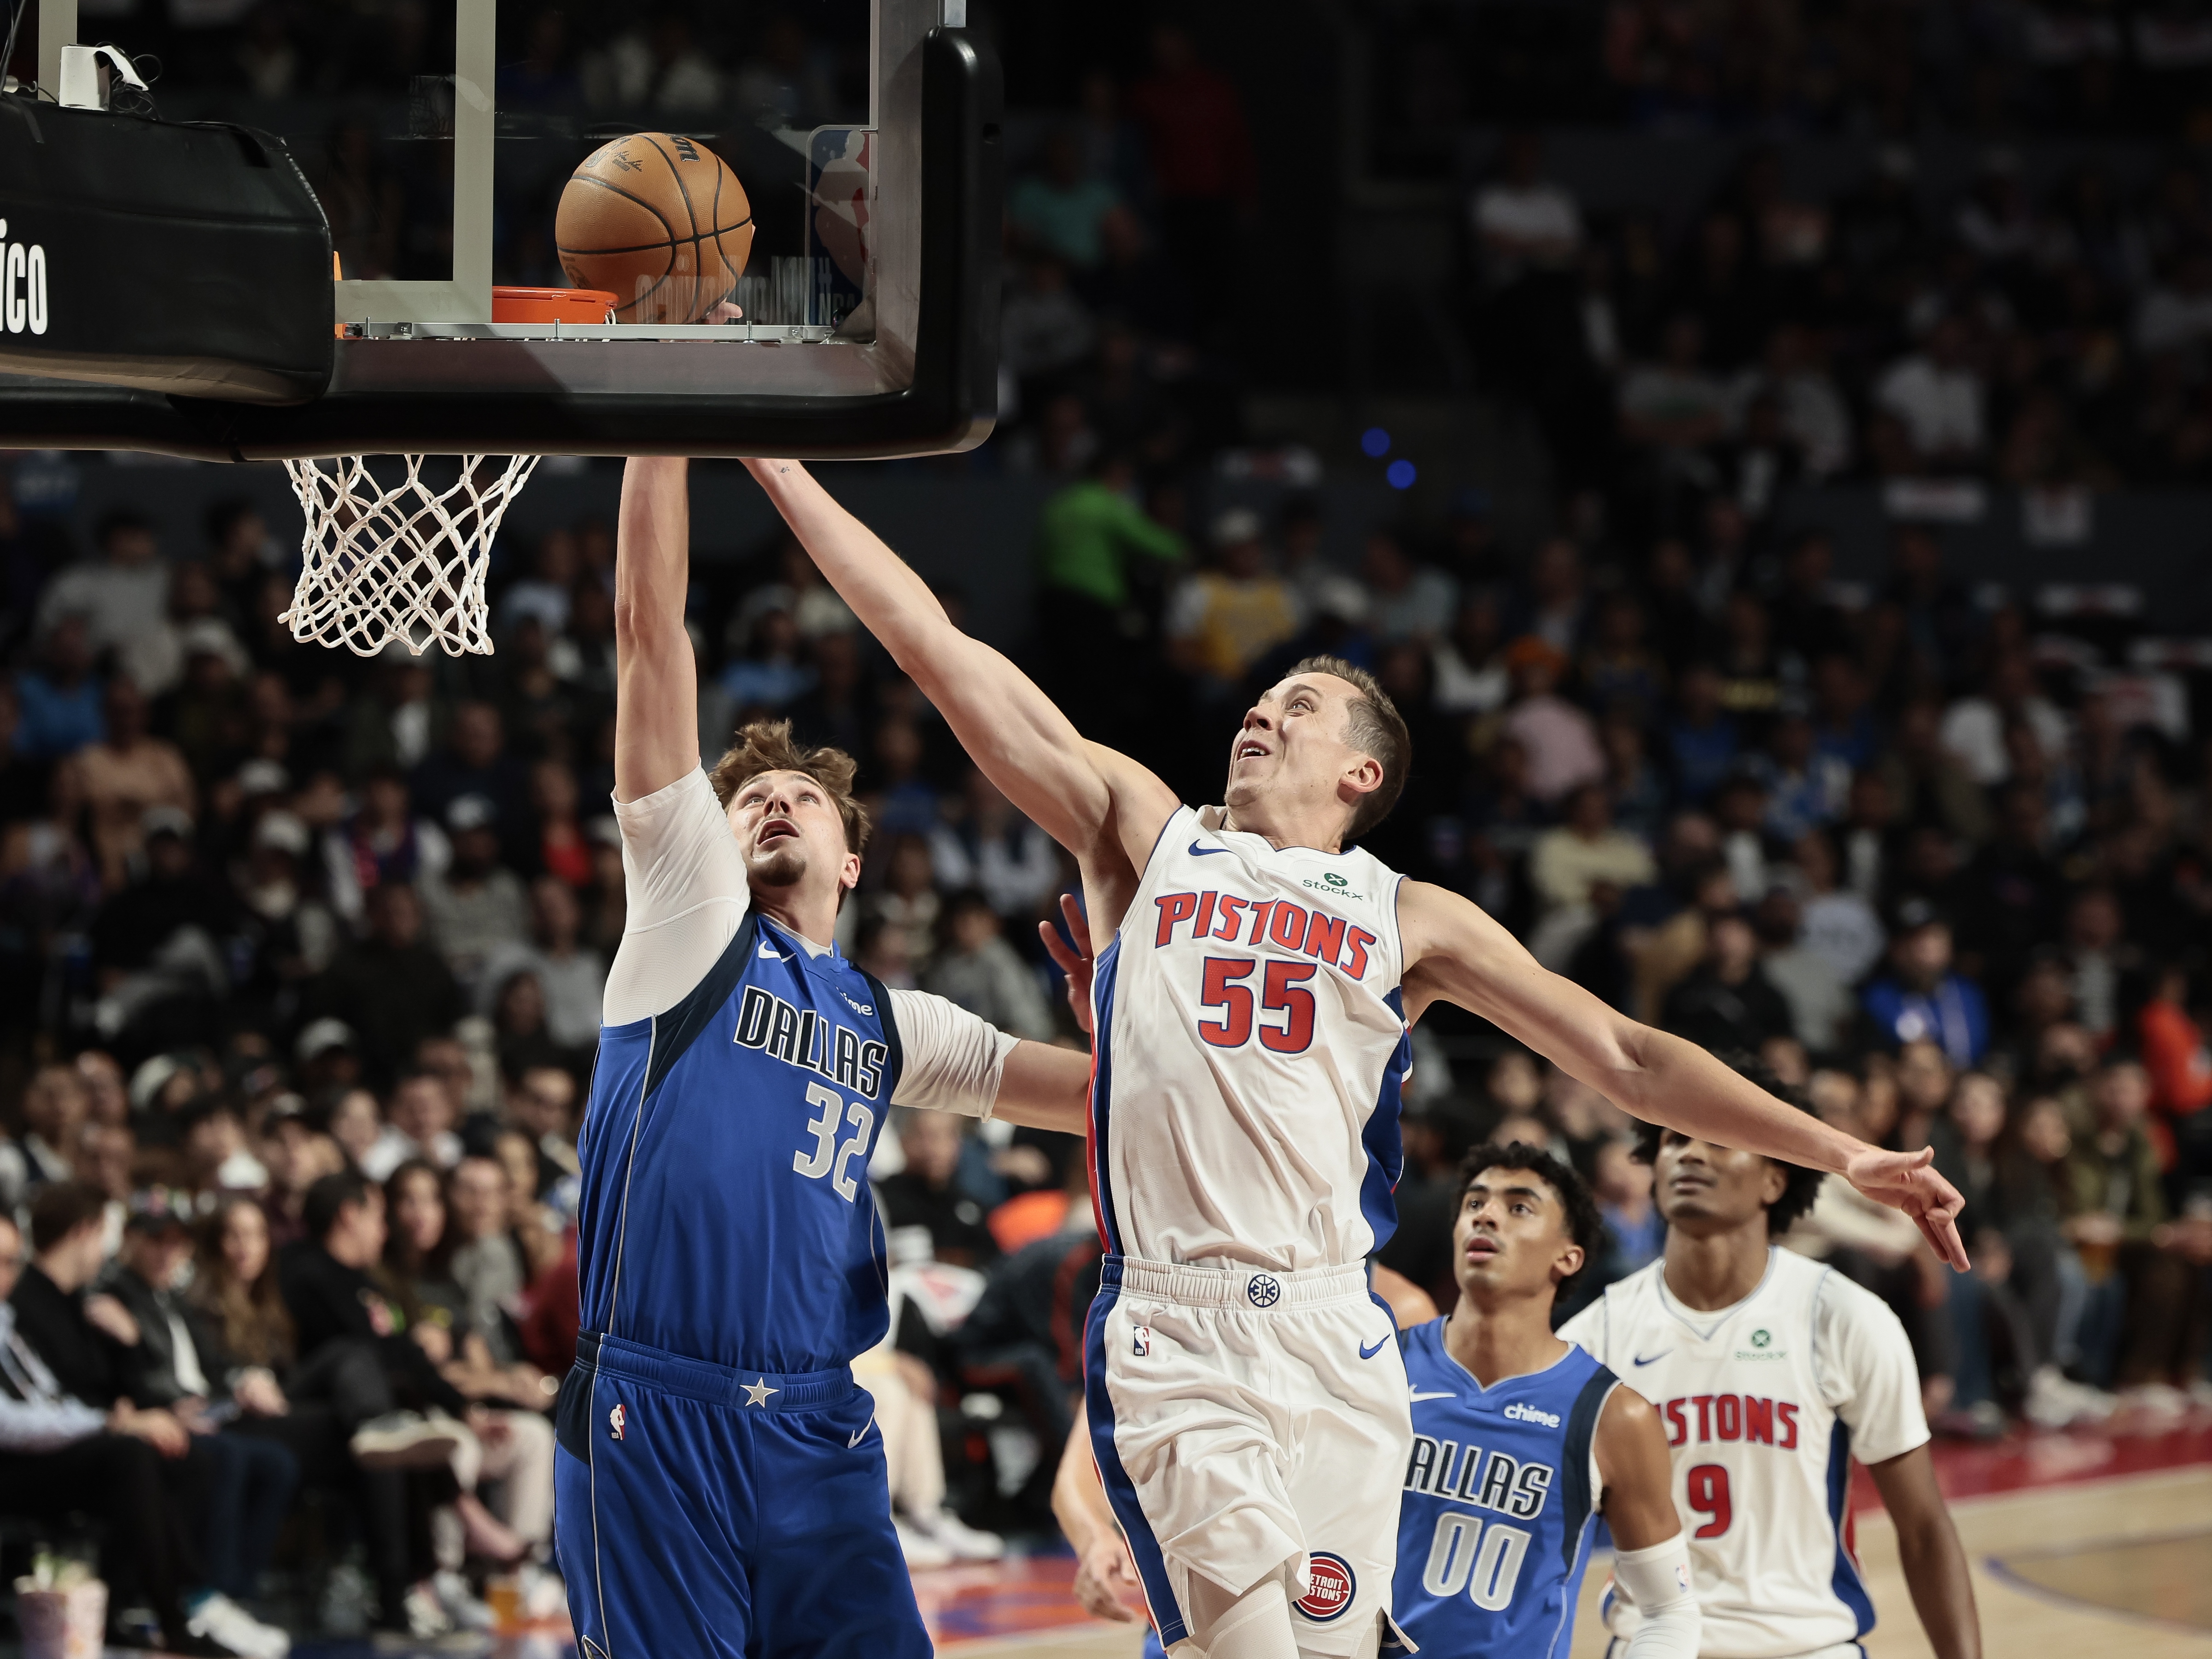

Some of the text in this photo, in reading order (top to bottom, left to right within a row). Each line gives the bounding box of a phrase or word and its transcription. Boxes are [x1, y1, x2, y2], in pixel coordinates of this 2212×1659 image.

[1302, 879, 1363, 901] StockX
[1155, 891, 1377, 981] PISTONS
[836, 986, 873, 1016] ime
[1198, 956, 1318, 1054] 55
[733, 985, 888, 1100] DALLAS
[793, 1081, 874, 1203] 32
[1504, 1402, 1561, 1429] chime
[1654, 1394, 1799, 1450] STONS
[1403, 1432, 1554, 1521] ALLAS
[1687, 1464, 1732, 1539] 9
[1310, 1573, 1344, 1590] ETROIT
[1310, 1585, 1342, 1601] STONS
[1423, 1511, 1532, 1612] 00
